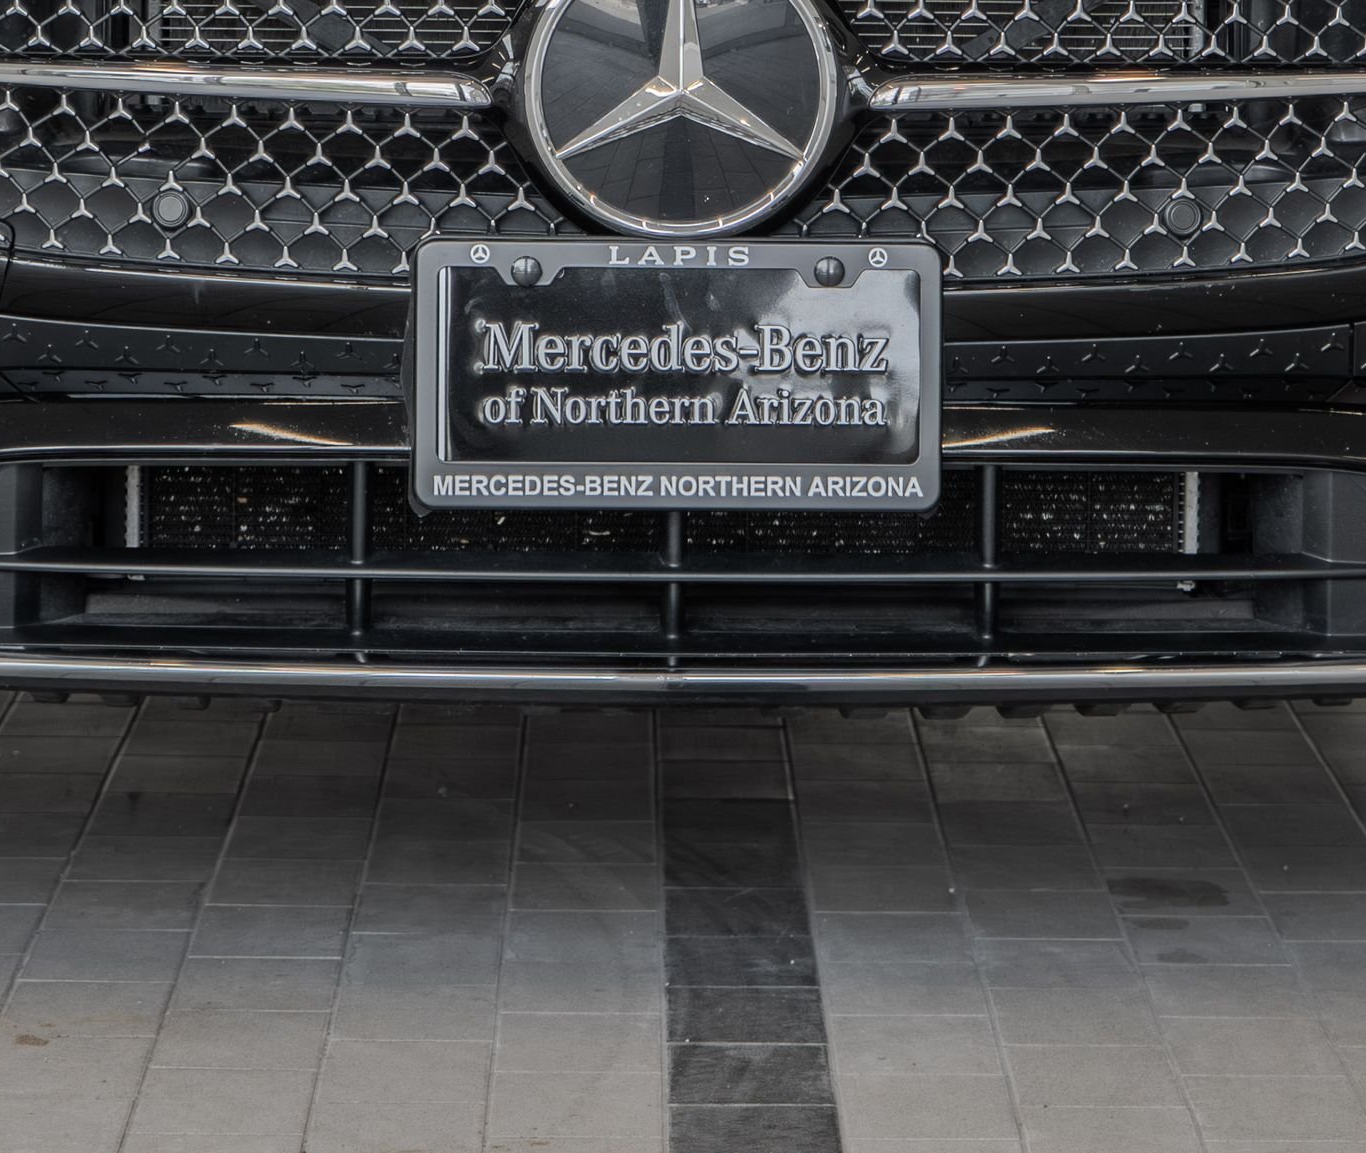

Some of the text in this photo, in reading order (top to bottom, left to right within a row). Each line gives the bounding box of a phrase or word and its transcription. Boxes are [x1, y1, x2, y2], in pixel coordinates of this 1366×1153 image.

[608, 245, 751, 266] LAPIS
[482, 322, 889, 374] Mercedes-Benz
[483, 387, 887, 426] of Northern Arizona
[433, 474, 924, 498] MERCEDES-BENZ NORTHERN ARIZONA
